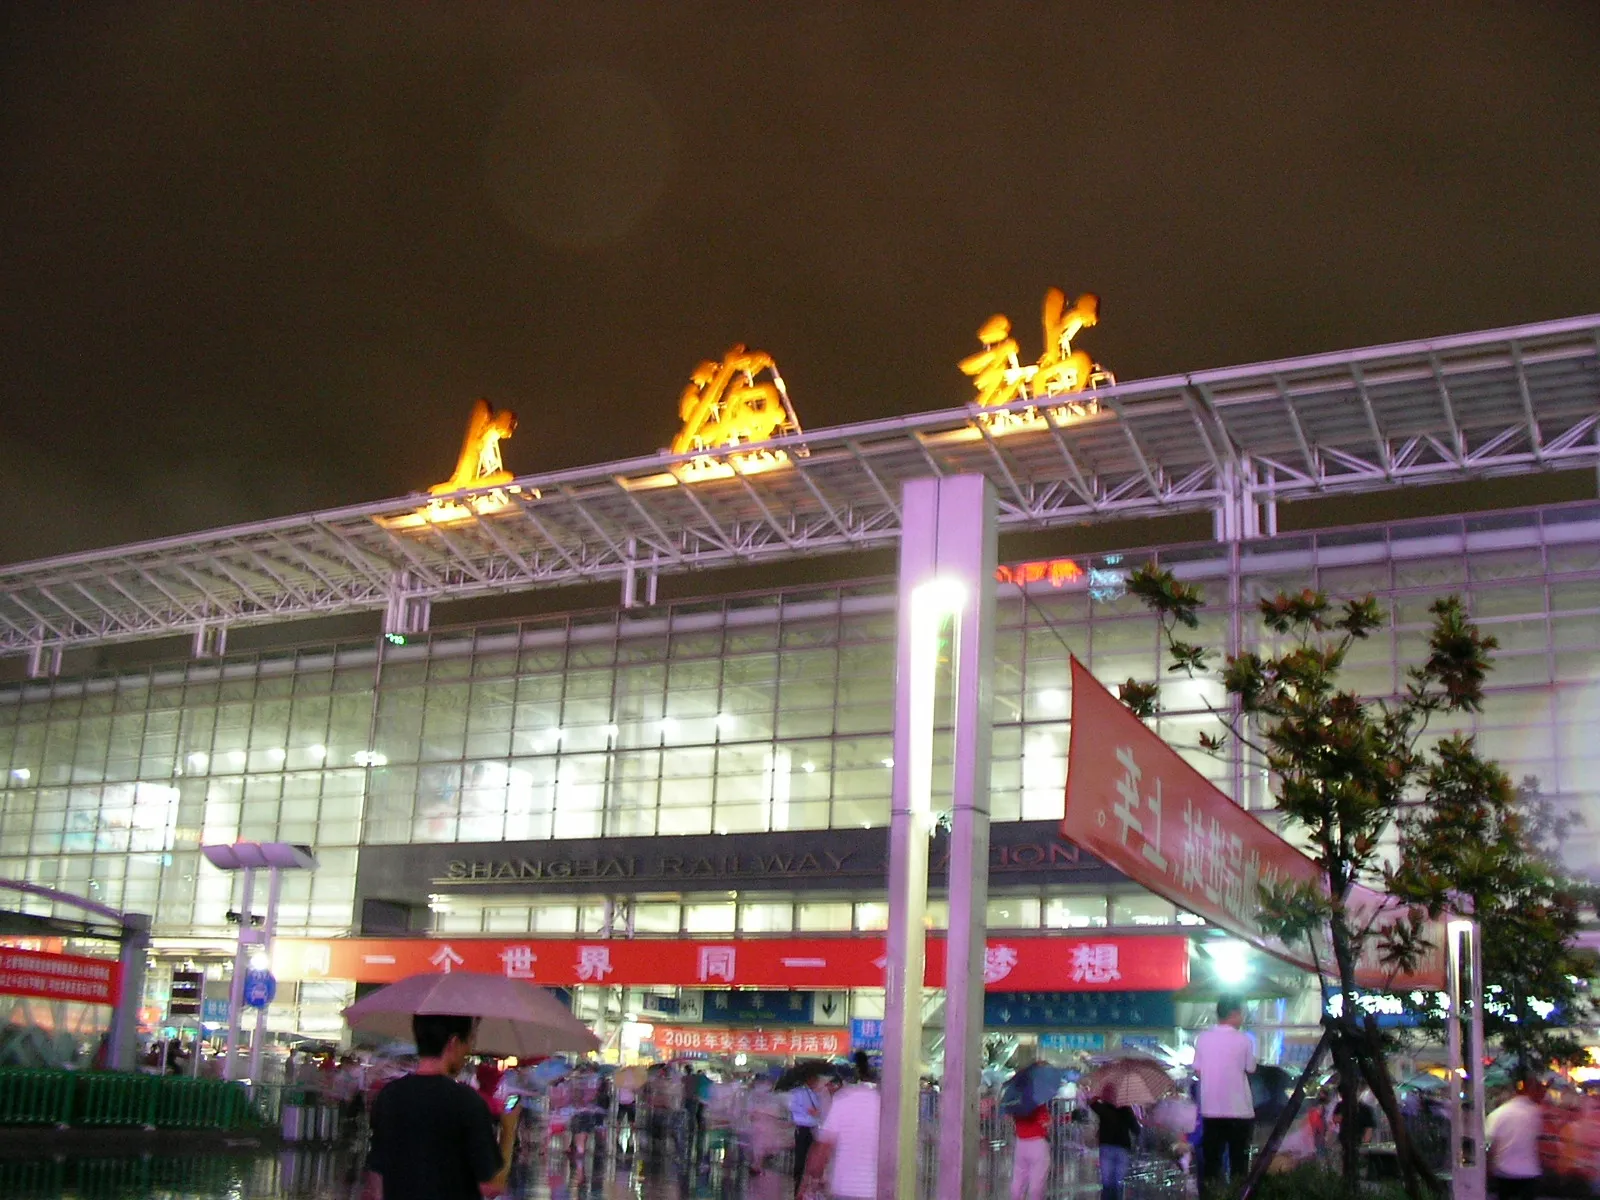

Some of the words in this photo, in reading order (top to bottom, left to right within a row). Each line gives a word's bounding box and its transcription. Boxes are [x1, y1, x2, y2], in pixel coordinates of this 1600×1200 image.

[446, 857, 637, 880] SHANGHAI
[659, 851, 857, 877] RAILWAY
[697, 943, 1121, 983] 同一梦想
